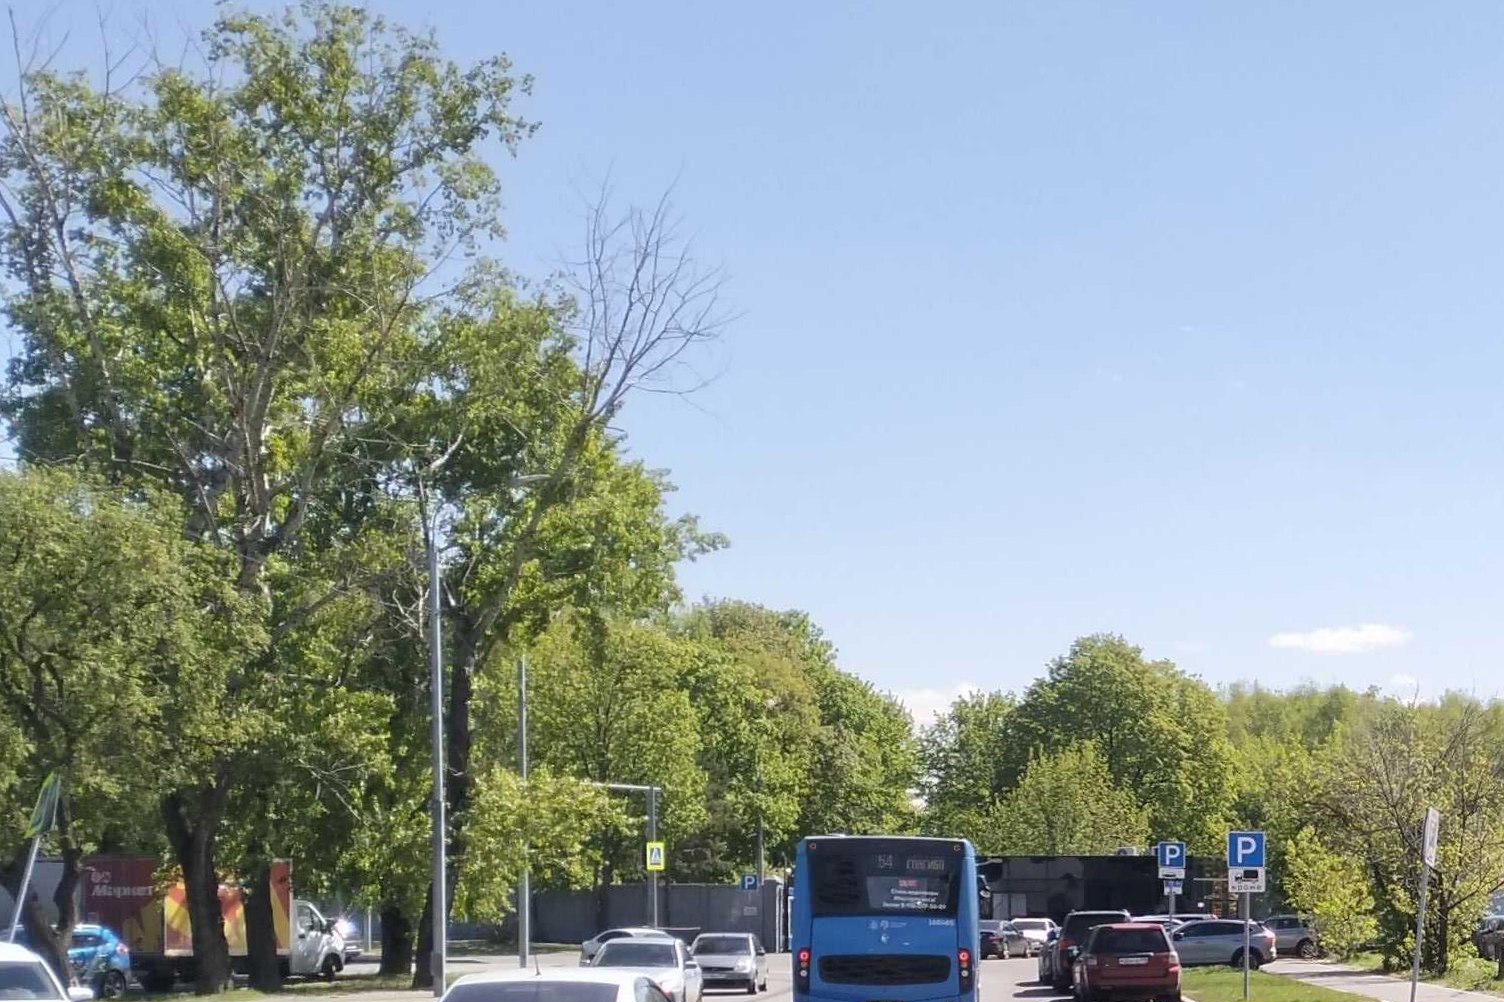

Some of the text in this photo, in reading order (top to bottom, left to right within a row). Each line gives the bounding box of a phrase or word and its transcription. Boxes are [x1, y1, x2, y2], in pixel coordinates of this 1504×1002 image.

[1165, 845, 1180, 865] P
[1237, 837, 1257, 863] P
[745, 875, 755, 888] P
[92, 884, 154, 898] Маркет
